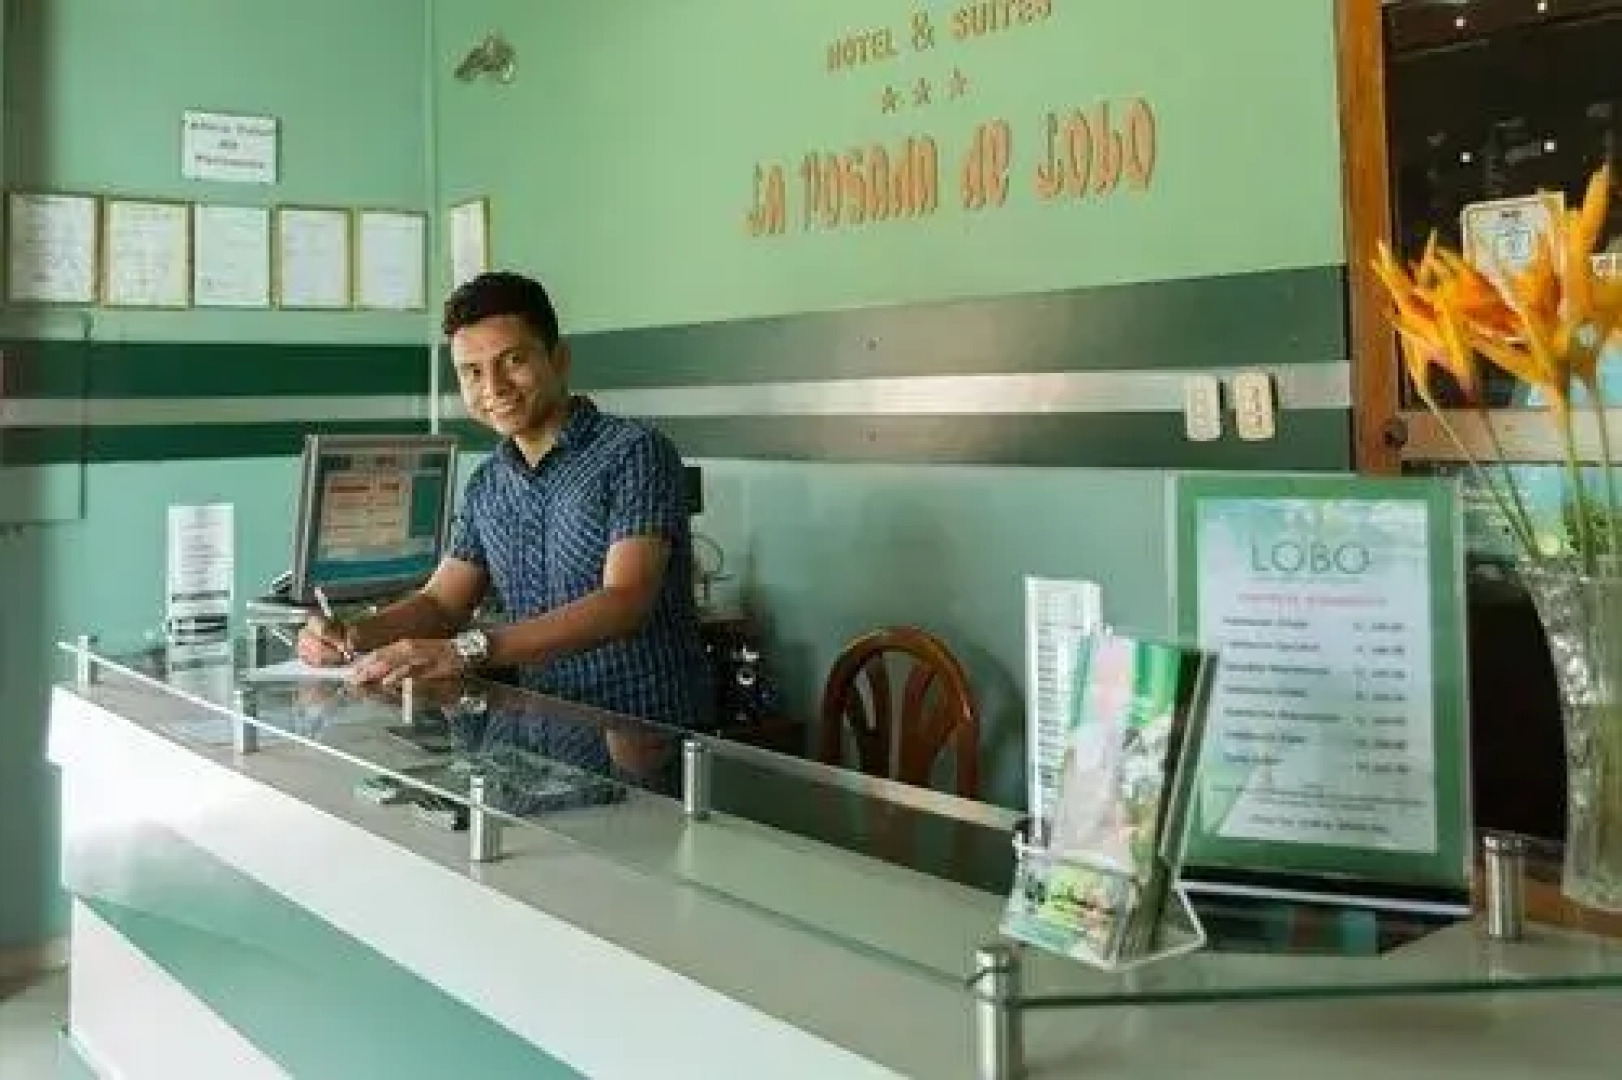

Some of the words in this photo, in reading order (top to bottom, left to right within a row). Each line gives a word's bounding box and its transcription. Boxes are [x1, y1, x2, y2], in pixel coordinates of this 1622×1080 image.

[827, 28, 898, 70] HOTEL
[911, 10, 934, 51] &
[1251, 540, 1370, 575] LOBO
